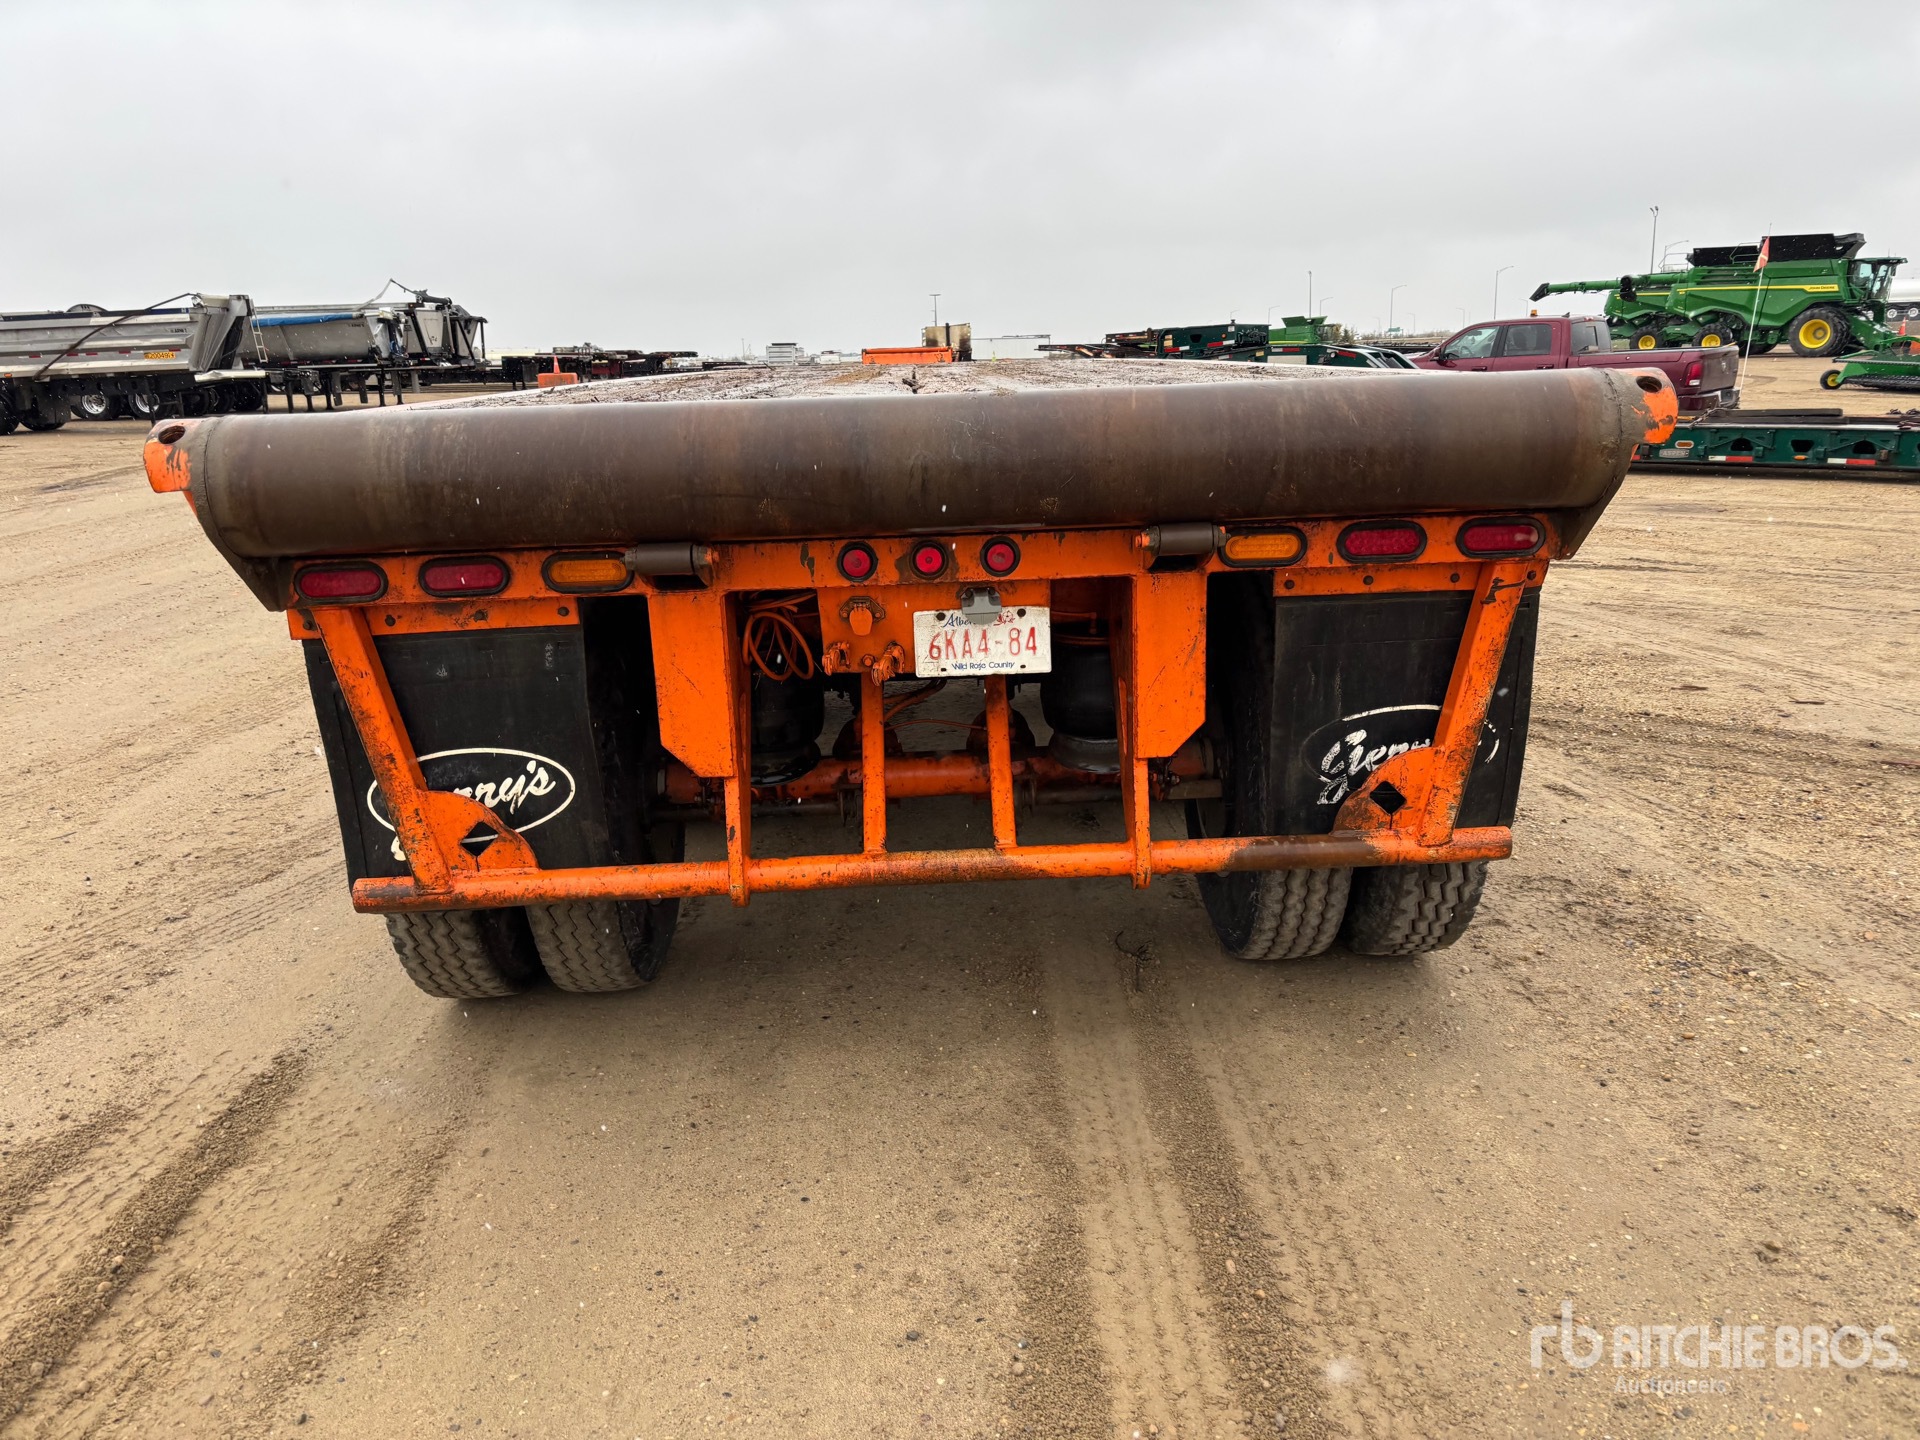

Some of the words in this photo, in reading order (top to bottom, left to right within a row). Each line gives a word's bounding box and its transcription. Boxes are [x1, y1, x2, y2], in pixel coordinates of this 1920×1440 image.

[943, 613, 976, 628] Albe
[969, 662, 986, 670] Rose
[988, 661, 1015, 669] Country
